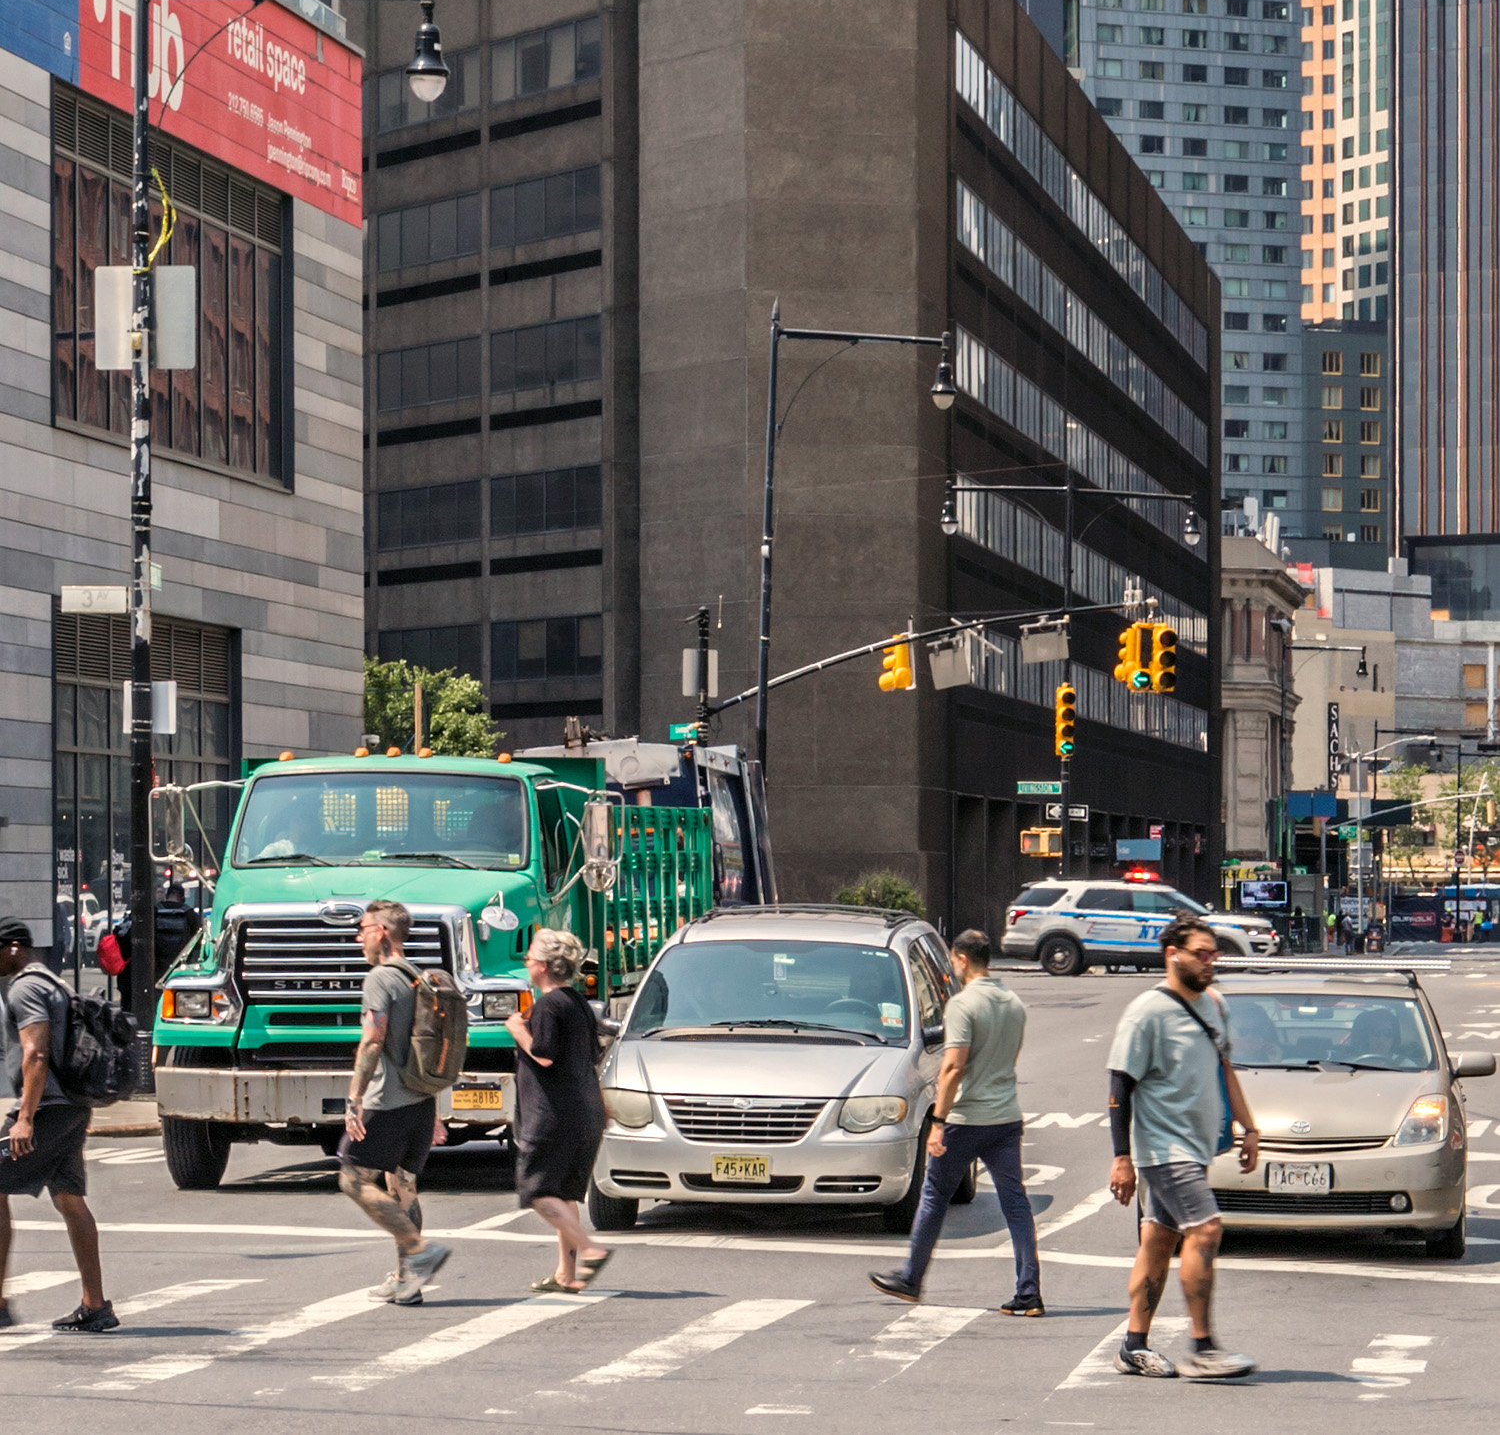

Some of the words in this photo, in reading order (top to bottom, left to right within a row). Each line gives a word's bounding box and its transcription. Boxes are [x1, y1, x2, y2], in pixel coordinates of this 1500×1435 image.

[228, 16, 264, 73] retail
[266, 40, 306, 95] space
[81, 589, 94, 608] 3
[1329, 705, 1340, 788] SACHS
[1137, 924, 1163, 939] NY
[273, 980, 360, 989] STERL
